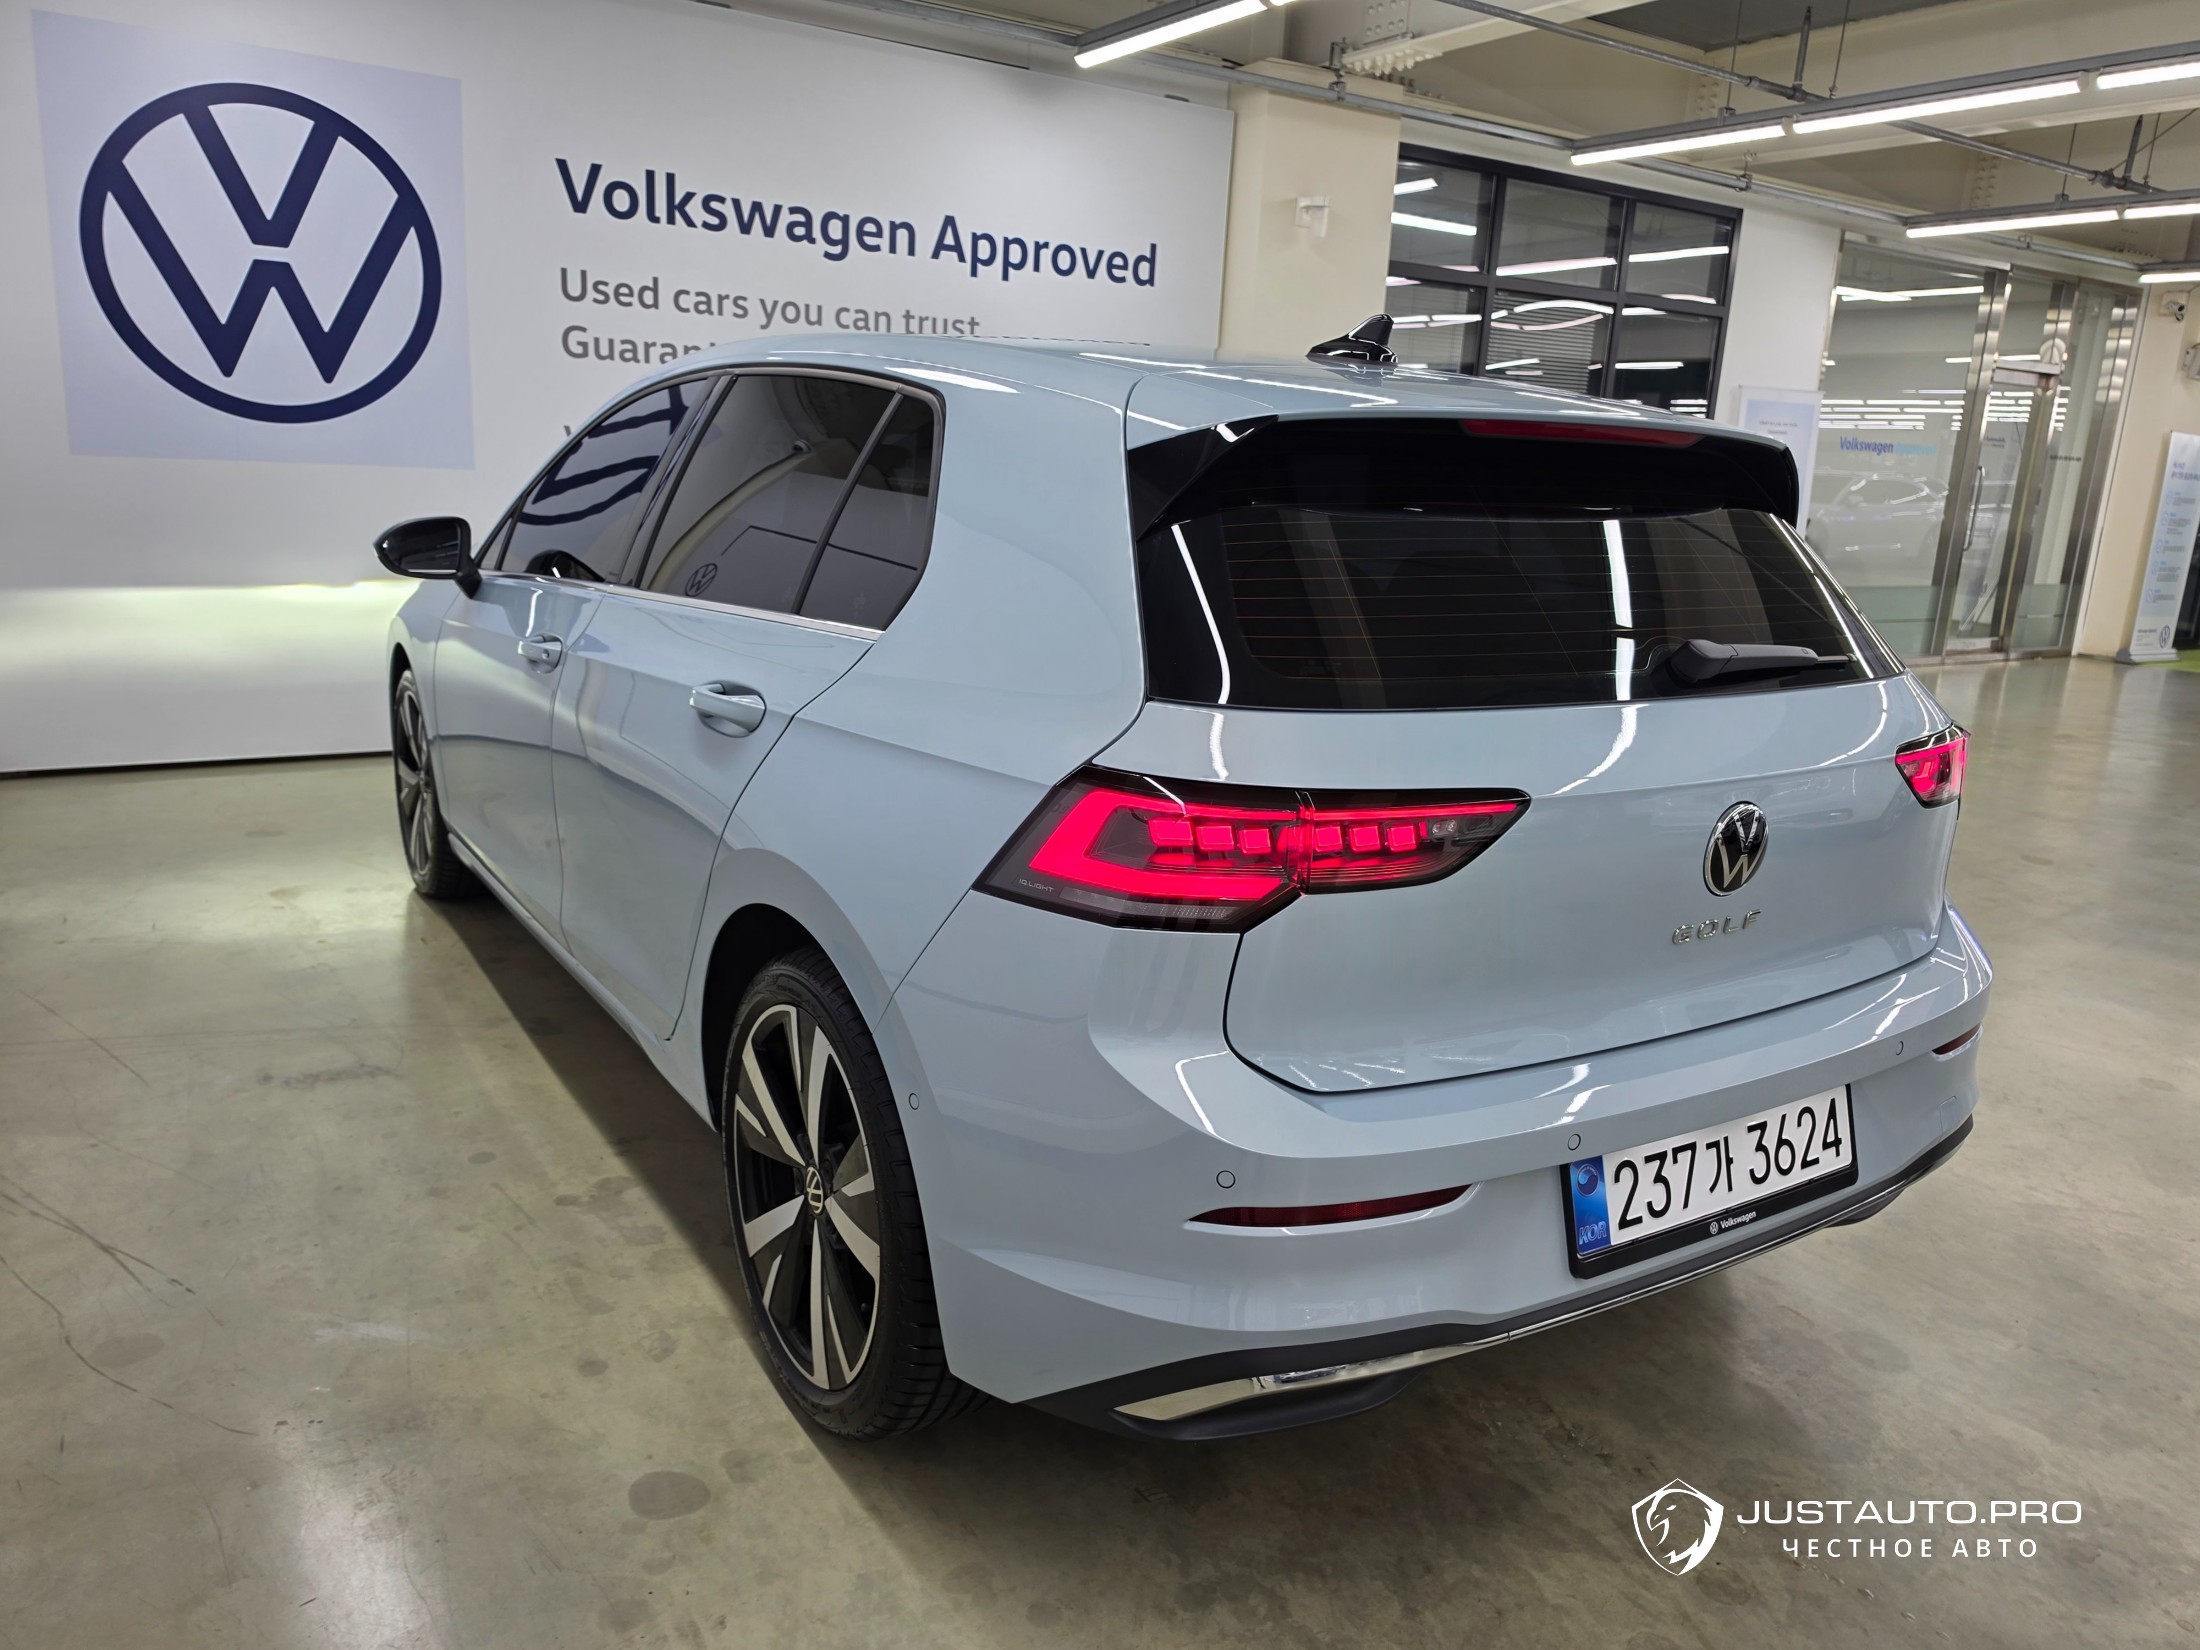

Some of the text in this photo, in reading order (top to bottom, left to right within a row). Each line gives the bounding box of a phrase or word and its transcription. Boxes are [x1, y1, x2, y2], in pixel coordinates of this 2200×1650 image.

[555, 157, 1158, 288] Volkswagen Approved
[559, 267, 980, 335] Used cars you can trust
[561, 325, 716, 364] Guara
[1840, 435, 1894, 456] Volkswagen
[1019, 878, 1054, 893] IQ.LIGHT
[1672, 909, 1762, 945] GOLF
[1613, 1097, 1843, 1231] 237가 3624
[1578, 1221, 1607, 1245] KOR
[1720, 1210, 1757, 1229] Volkswagen
